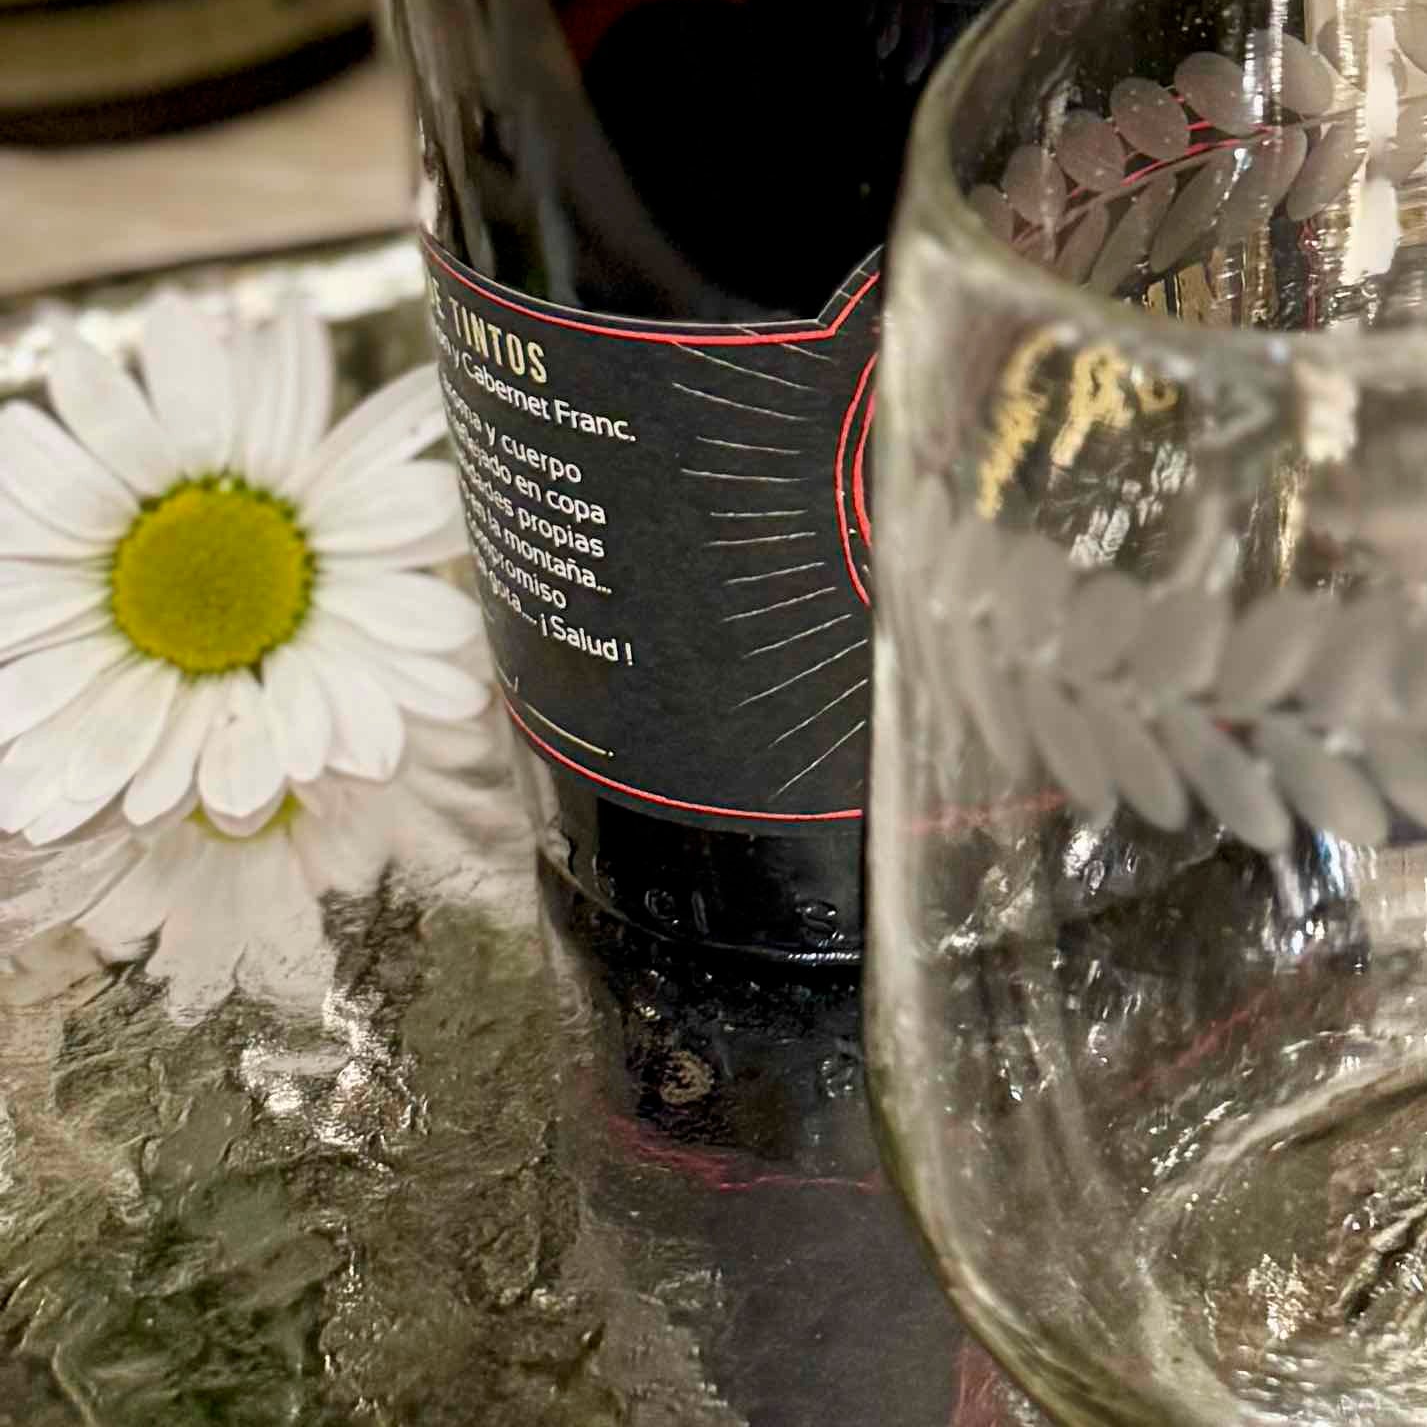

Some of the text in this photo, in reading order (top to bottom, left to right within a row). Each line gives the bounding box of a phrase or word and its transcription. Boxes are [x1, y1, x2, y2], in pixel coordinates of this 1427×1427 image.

[448, 296, 548, 384] TINTOS
[461, 350, 551, 421] Cabernet
[554, 399, 637, 442] Franc.
[484, 422, 496, 447] y
[500, 434, 582, 483] cuerpo
[515, 474, 542, 503] en
[545, 490, 607, 525] copa
[504, 528, 613, 594] montaña...
[518, 507, 606, 558] propias
